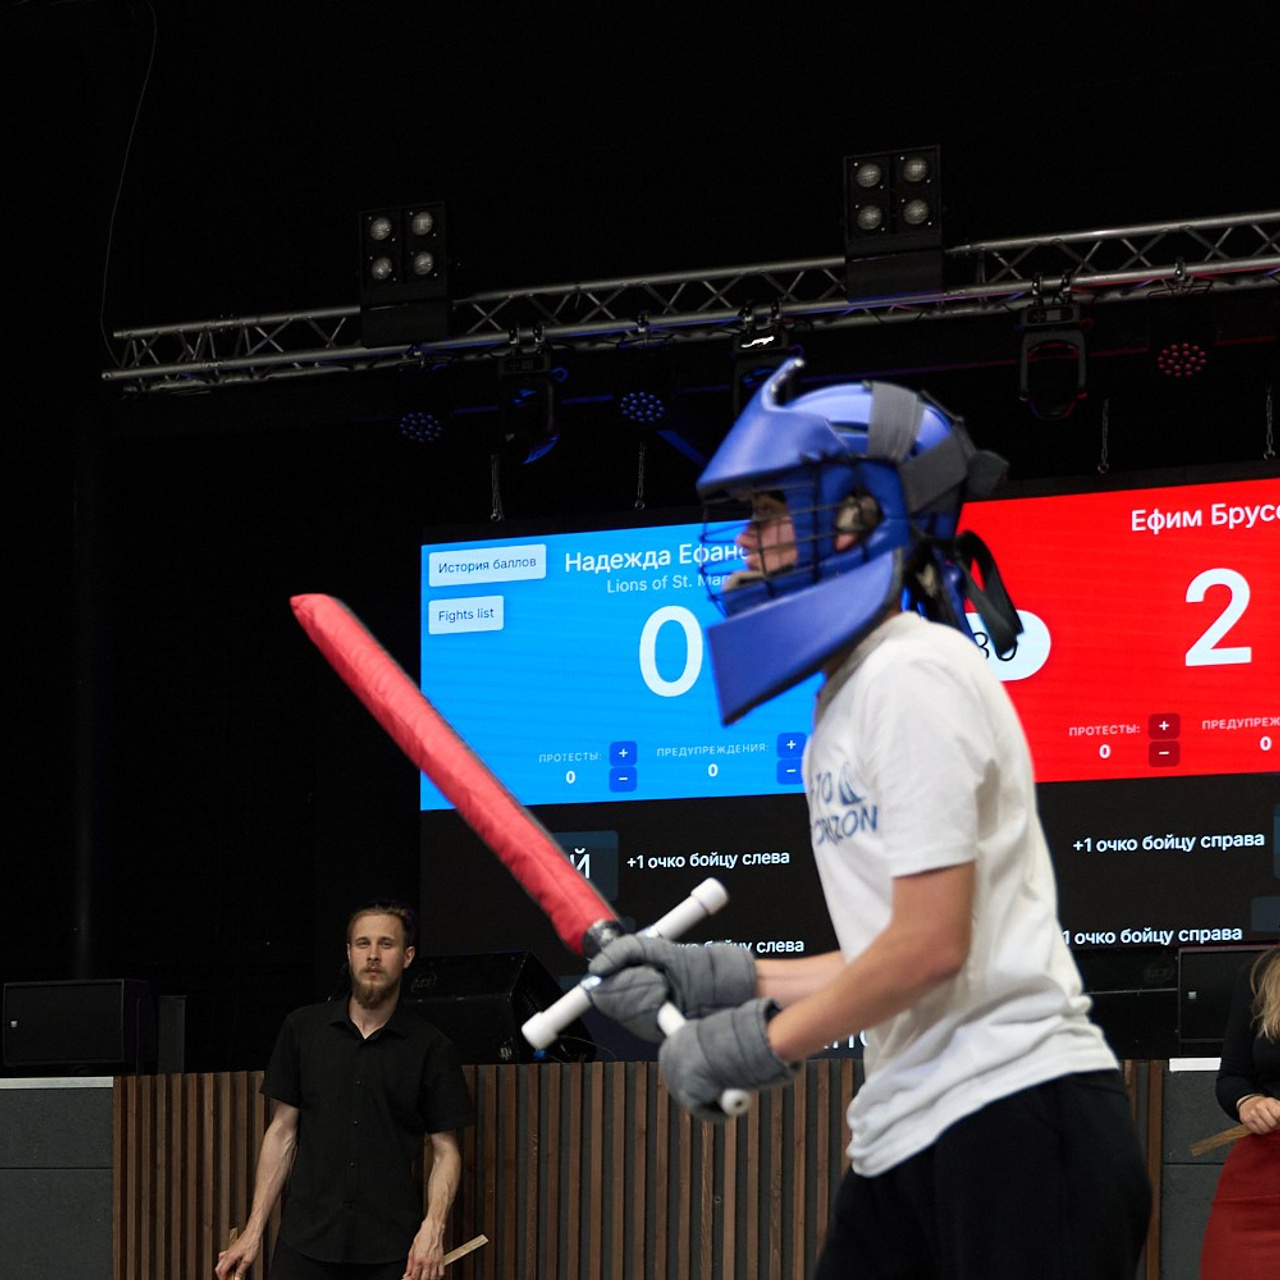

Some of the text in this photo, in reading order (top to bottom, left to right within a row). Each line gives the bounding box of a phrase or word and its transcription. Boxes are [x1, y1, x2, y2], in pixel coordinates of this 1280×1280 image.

[1131, 503, 1280, 535] Ефим Брус
[438, 558, 537, 574] История баллов
[565, 550, 671, 574] Надежда
[607, 579, 648, 593] Lions
[652, 577, 668, 591] of
[672, 575, 693, 588] St.
[438, 608, 495, 624] Fights list
[1185, 568, 1252, 667] 2
[638, 605, 704, 698] 0
[1068, 724, 1140, 737] ПРОТЕСТЫ:
[656, 743, 769, 757] ПРЕДУПРЕЖДЕНИЯ:
[1099, 744, 1111, 759] 0
[1260, 736, 1272, 751] 0
[538, 752, 602, 763] ПРОТЕСТЫ:
[565, 771, 576, 784] 0
[708, 764, 719, 777] 0
[1073, 833, 1265, 852] +1 очко бойцу справа
[627, 852, 790, 869] +1 очко бойцу слева
[1074, 932, 1116, 945] очко
[1120, 927, 1174, 945] бойцу
[1178, 928, 1243, 944] справа
[756, 940, 805, 953] слева
